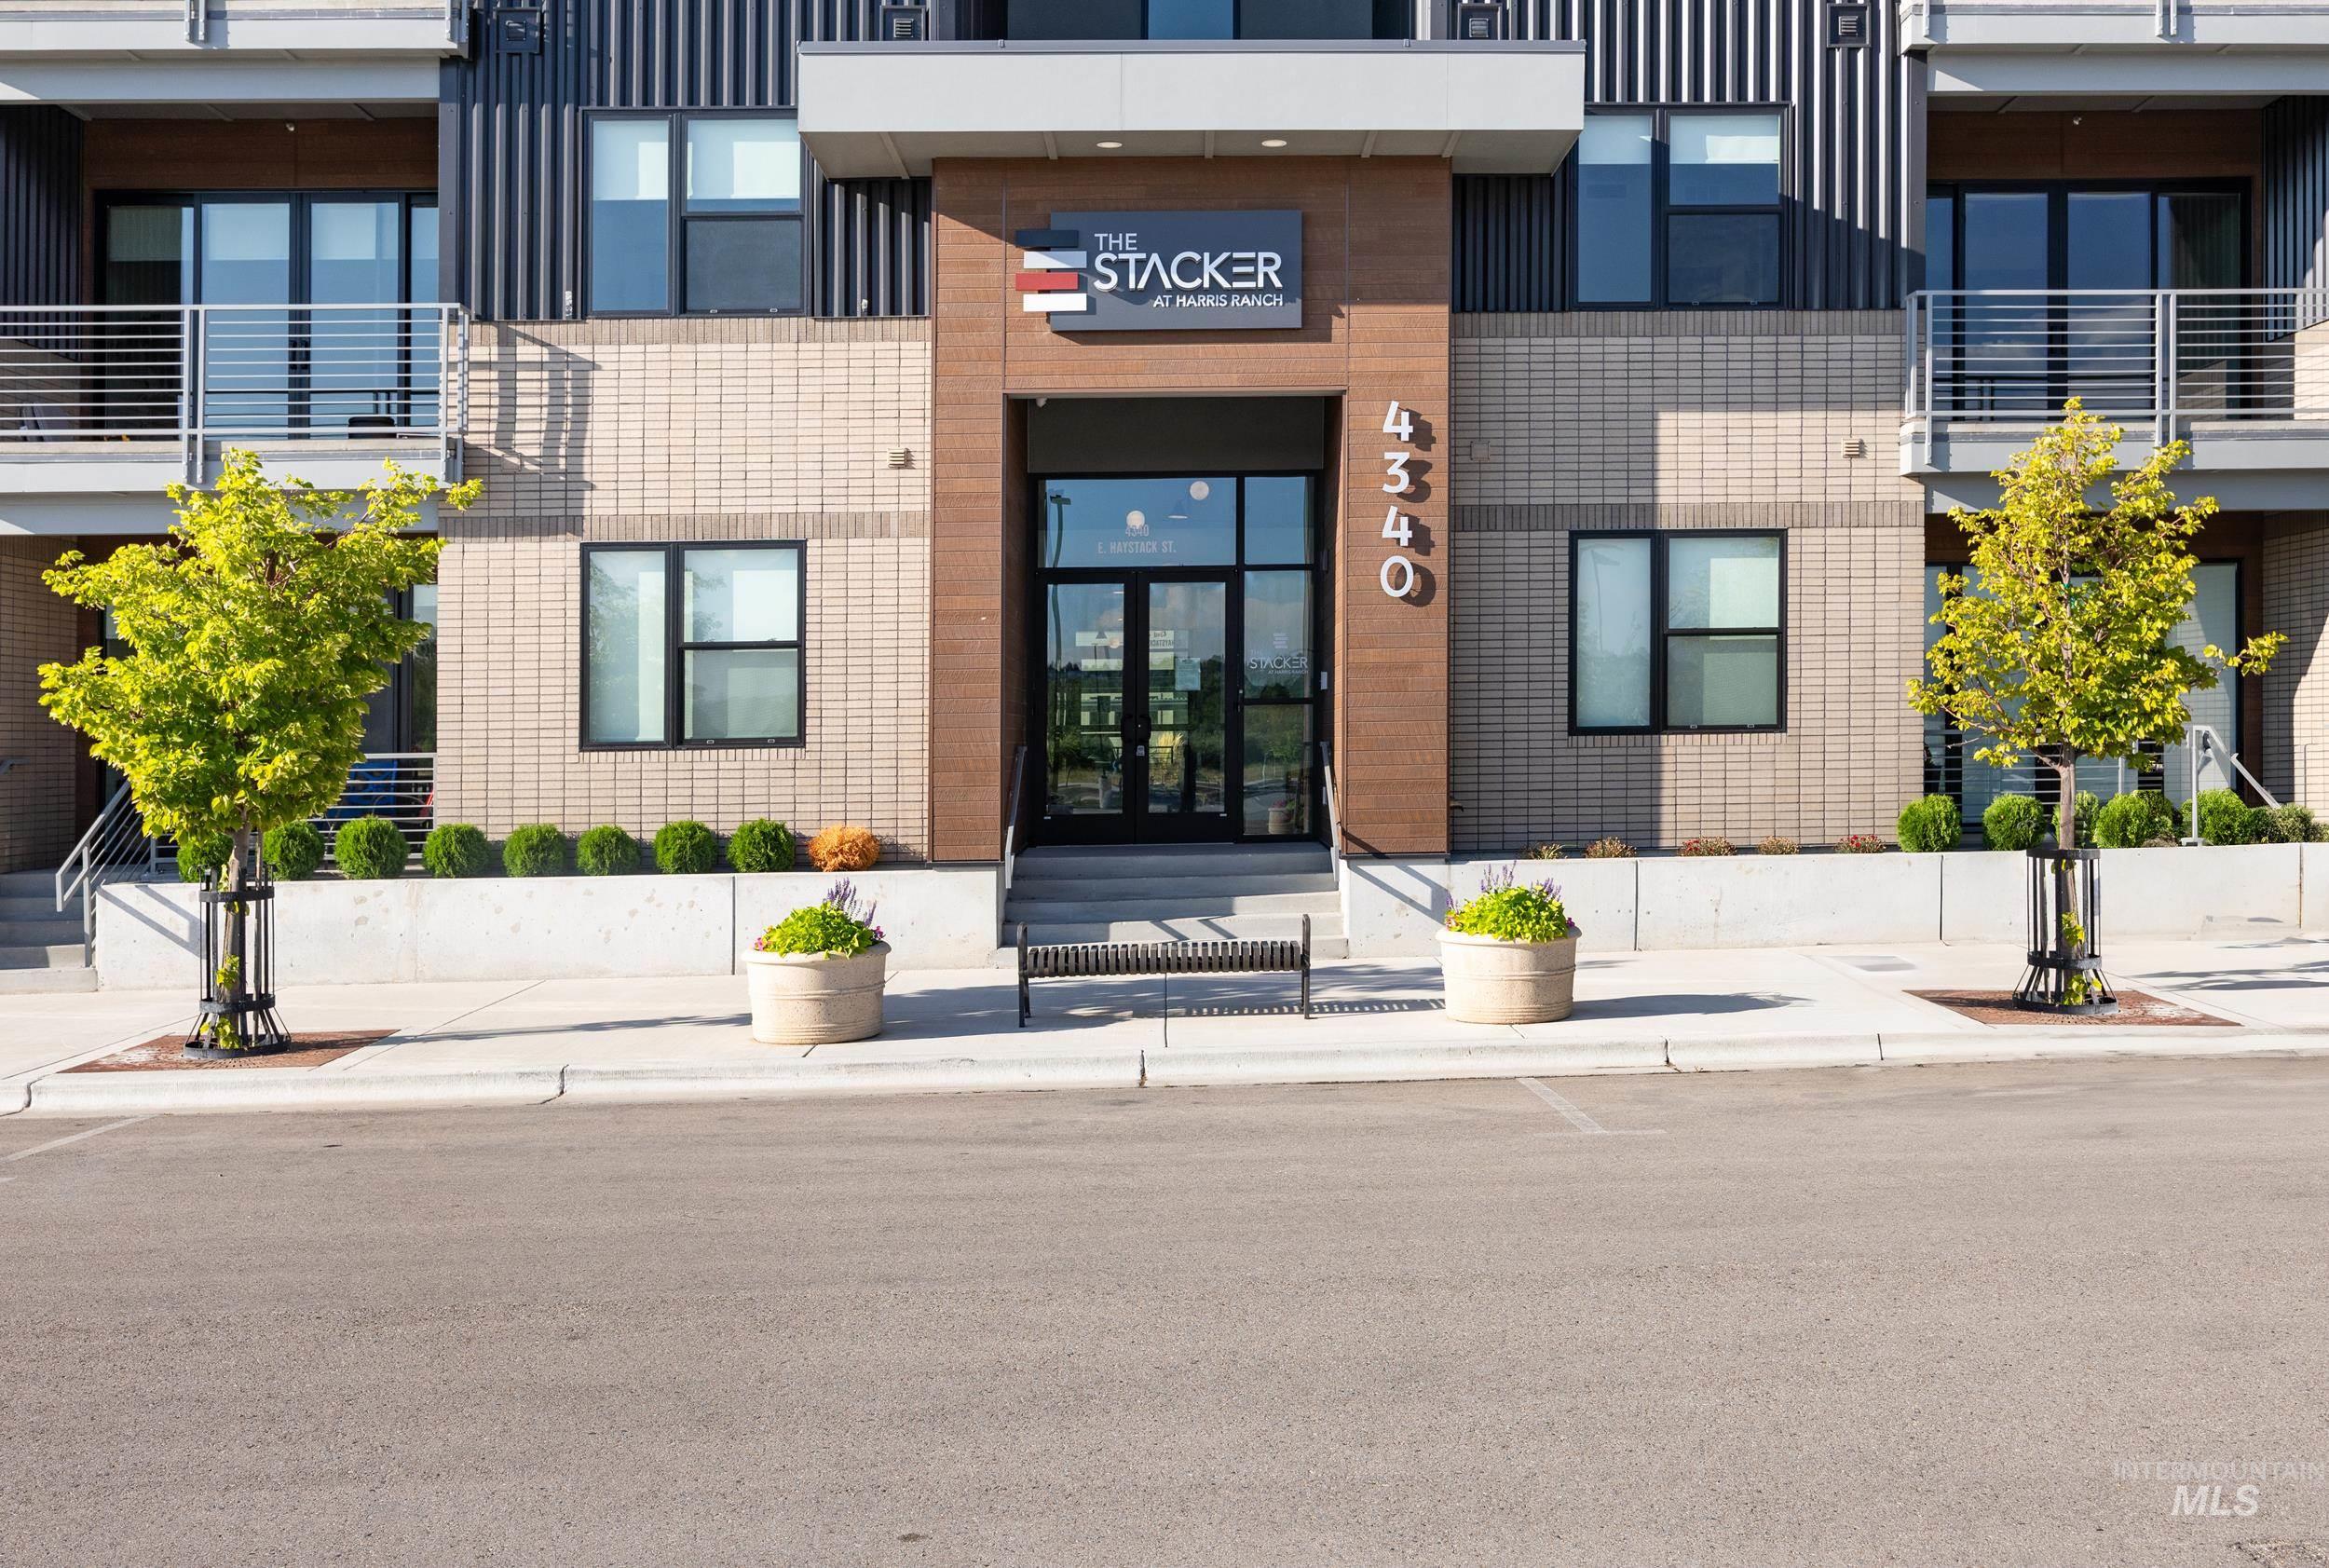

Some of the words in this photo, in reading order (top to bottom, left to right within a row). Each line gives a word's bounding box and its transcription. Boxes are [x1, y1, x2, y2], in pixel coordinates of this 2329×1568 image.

[1094, 233, 1137, 252] THE
[1093, 251, 1283, 293] STACKER
[1153, 295, 1172, 307] AT
[1176, 293, 1228, 307] HARRIS
[1232, 293, 1284, 307] RANCH
[1380, 401, 1414, 598] 4340
[1125, 525, 1149, 537] 4340
[1097, 541, 1107, 554] E.
[1110, 541, 1157, 553] HAYSTACK
[1162, 540, 1177, 553] ST.
[1249, 656, 1308, 669] STACKER
